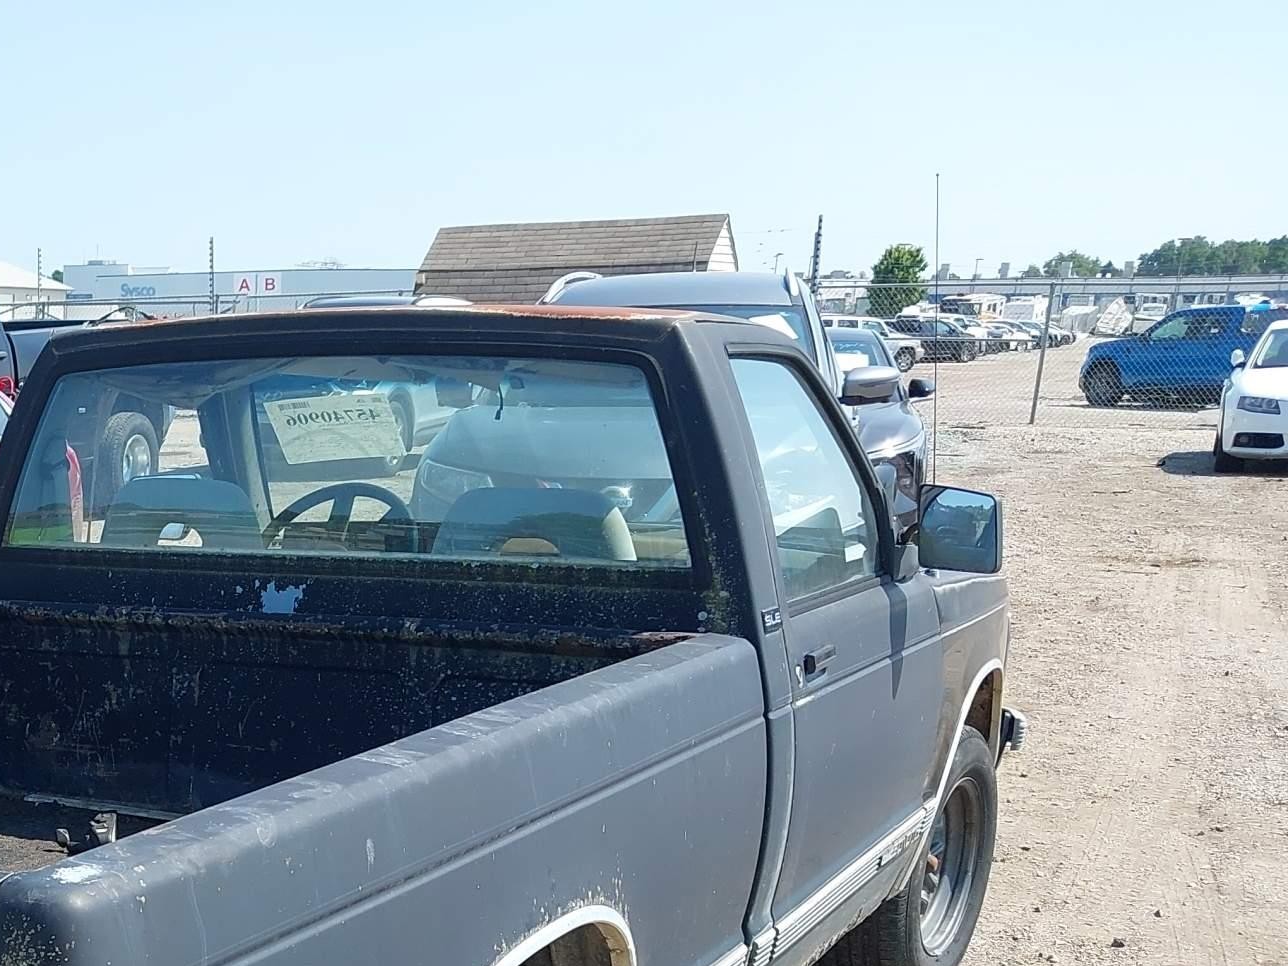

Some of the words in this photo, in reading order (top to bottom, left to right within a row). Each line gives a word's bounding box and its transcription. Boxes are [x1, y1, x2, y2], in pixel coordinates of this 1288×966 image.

[120, 283, 156, 297] Sysco
[239, 278, 250, 291] A
[264, 277, 276, 291] B
[764, 611, 782, 626] SLE
